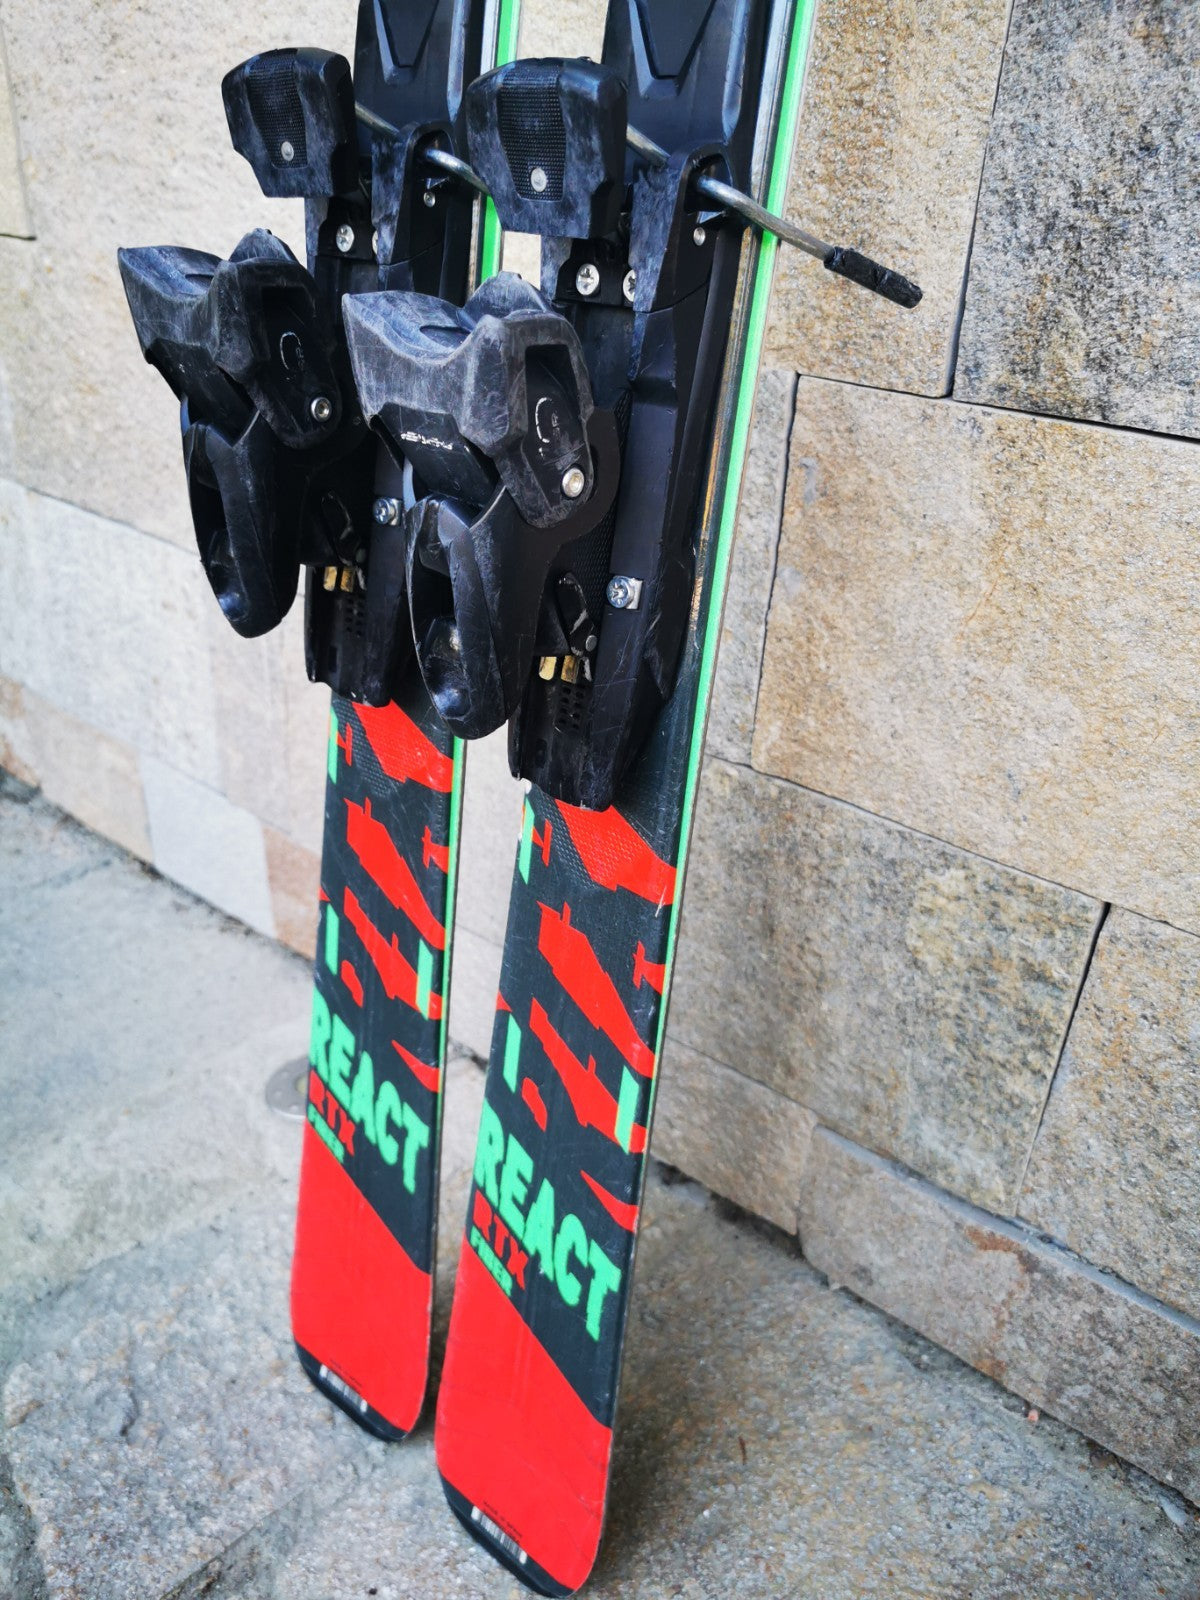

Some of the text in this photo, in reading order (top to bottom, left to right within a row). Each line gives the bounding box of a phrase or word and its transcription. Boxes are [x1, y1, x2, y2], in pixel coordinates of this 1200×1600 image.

[308, 986, 430, 1194] REACT
[309, 1068, 356, 1157] RTX
[473, 1097, 622, 1342] REACT
[473, 1189, 529, 1291] RTX
